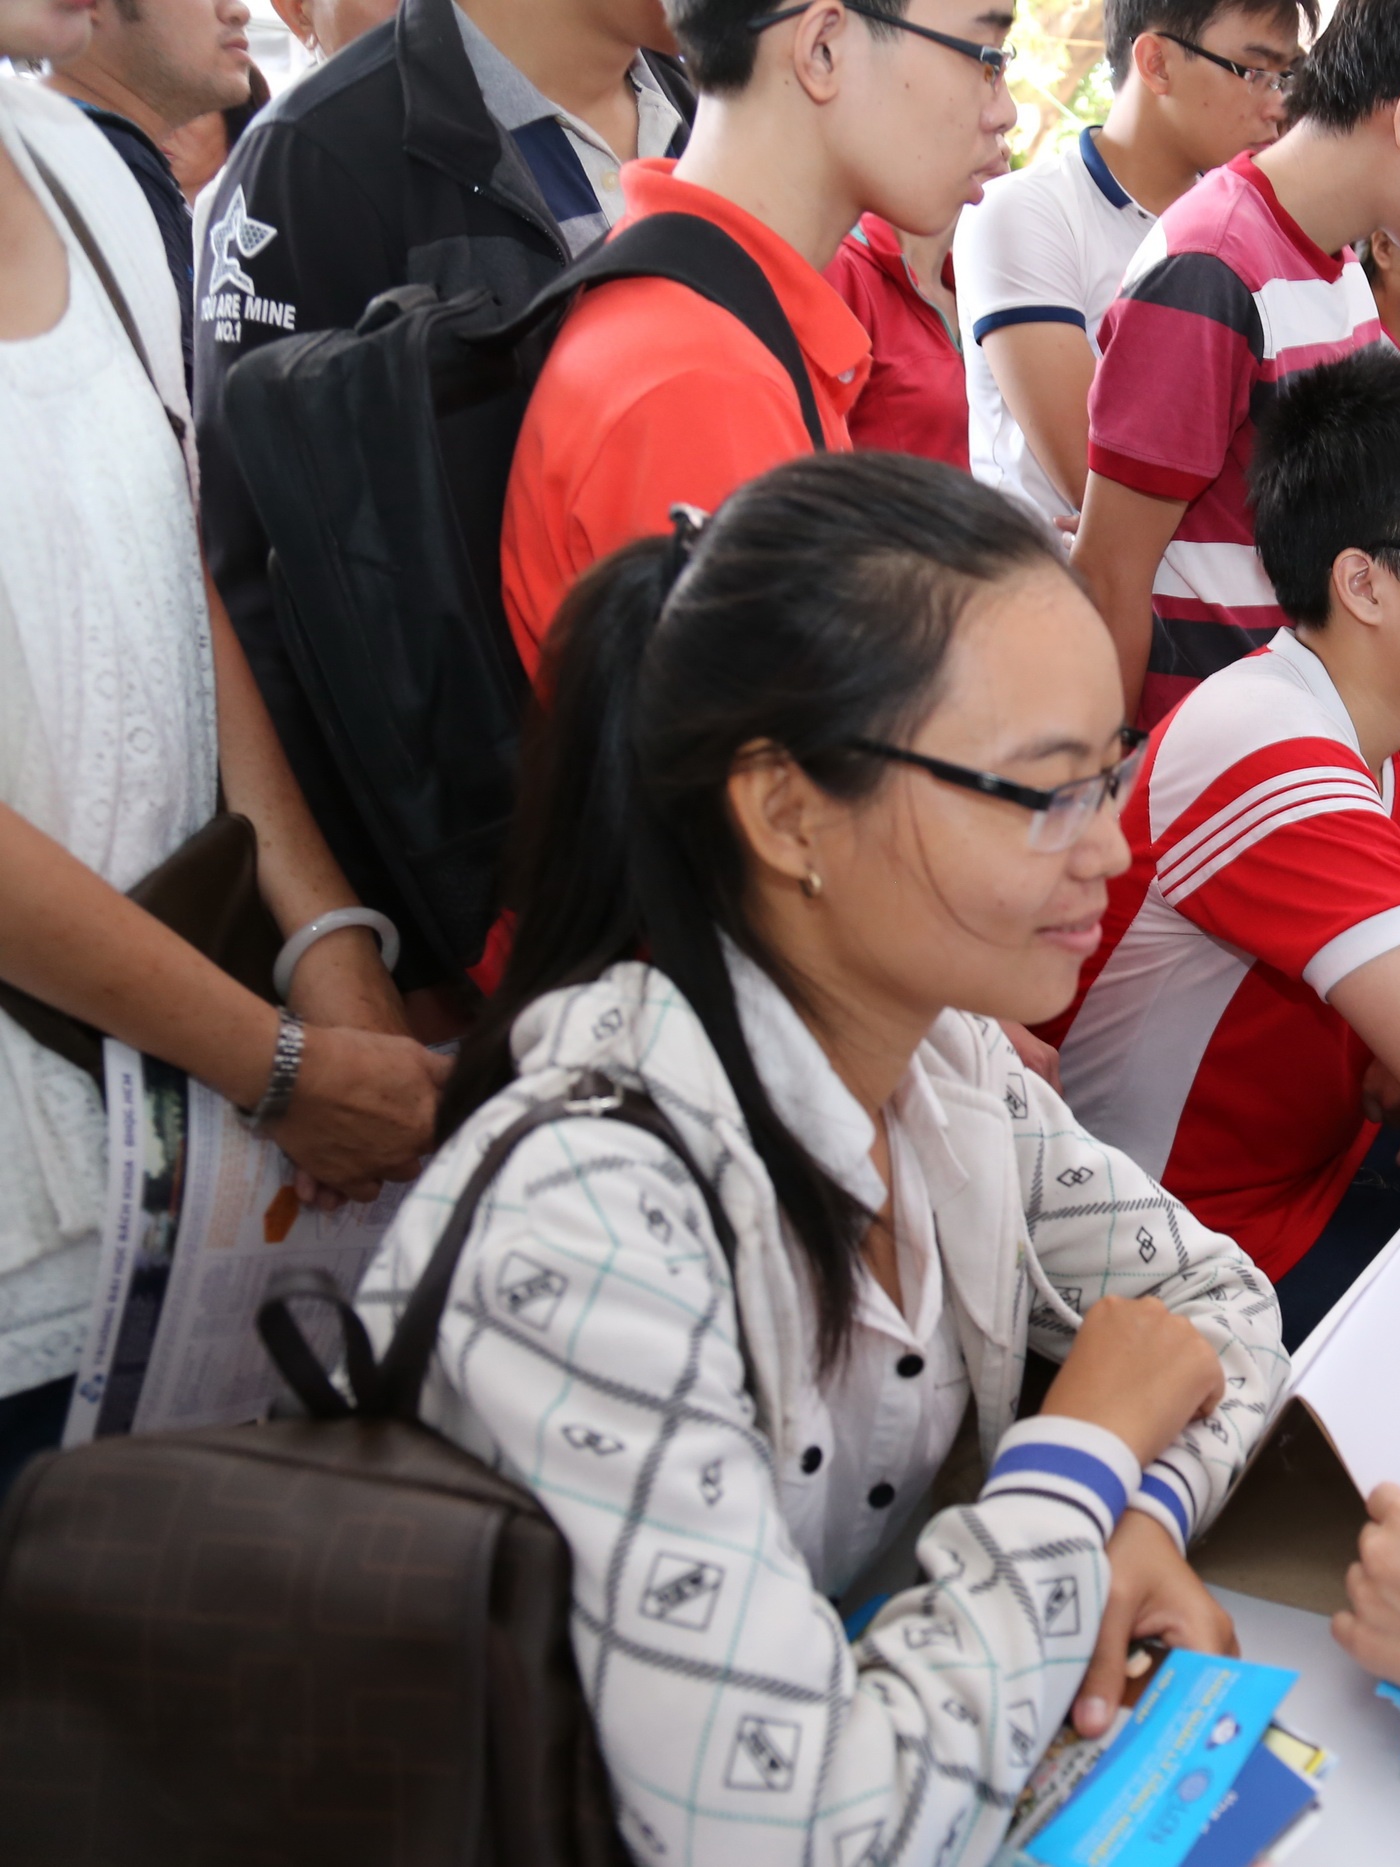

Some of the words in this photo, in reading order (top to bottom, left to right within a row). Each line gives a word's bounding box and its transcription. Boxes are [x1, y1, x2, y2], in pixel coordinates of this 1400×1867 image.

[216, 293, 242, 320] ARE
[244, 295, 296, 331] MINE
[214, 319, 243, 343] NO.1
